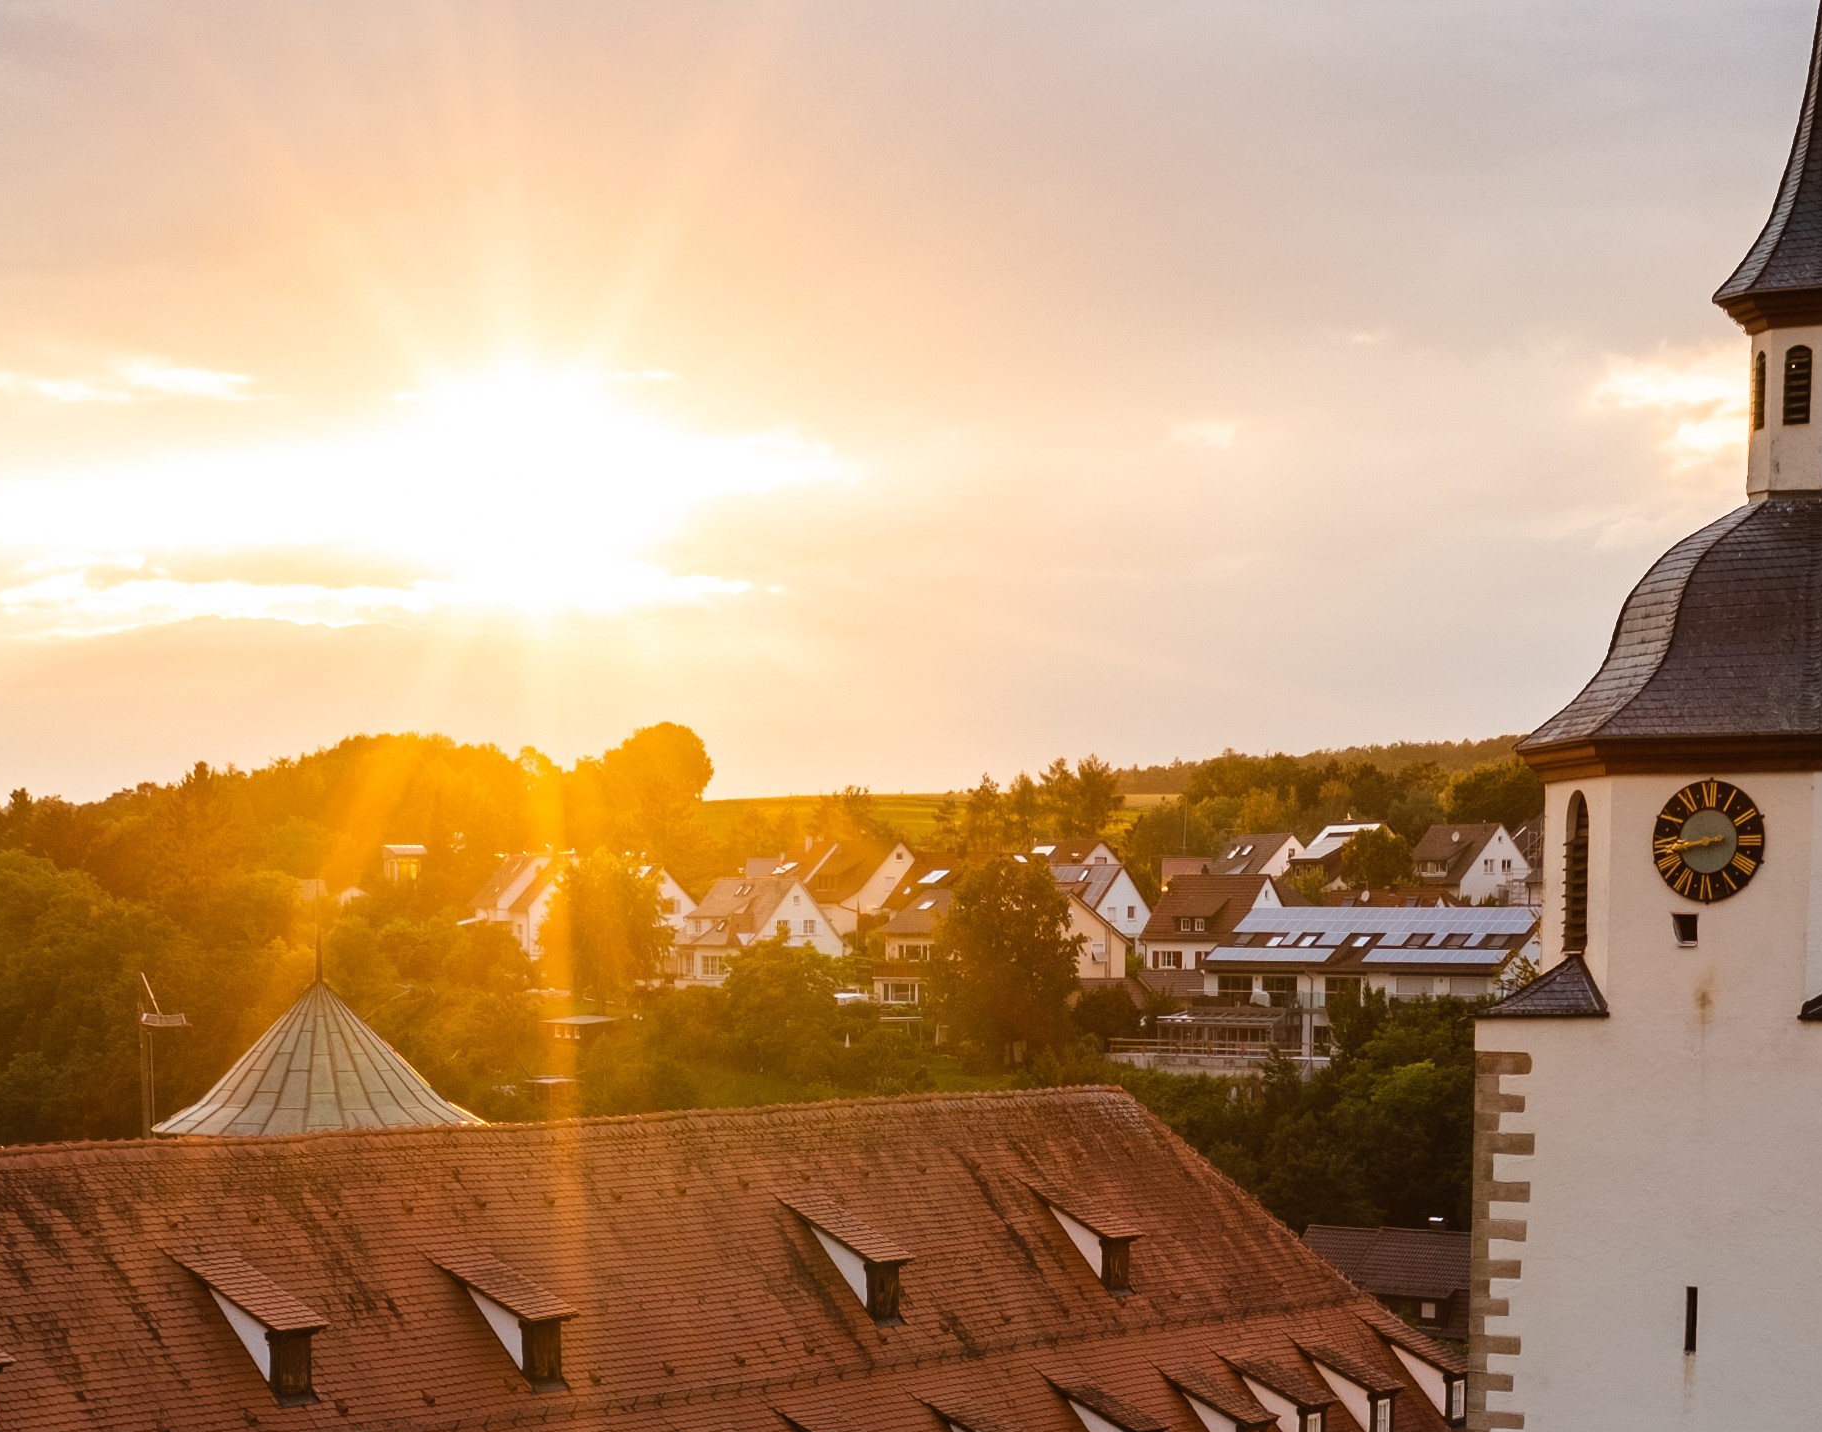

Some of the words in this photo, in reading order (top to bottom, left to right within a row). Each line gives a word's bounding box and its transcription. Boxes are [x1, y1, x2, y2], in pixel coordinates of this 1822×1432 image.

[1677, 787, 1698, 815] XI
[1701, 782, 1717, 808] XII
[1723, 789, 1737, 812] I
[1733, 808, 1757, 826] II
[1738, 834, 1762, 846] III
